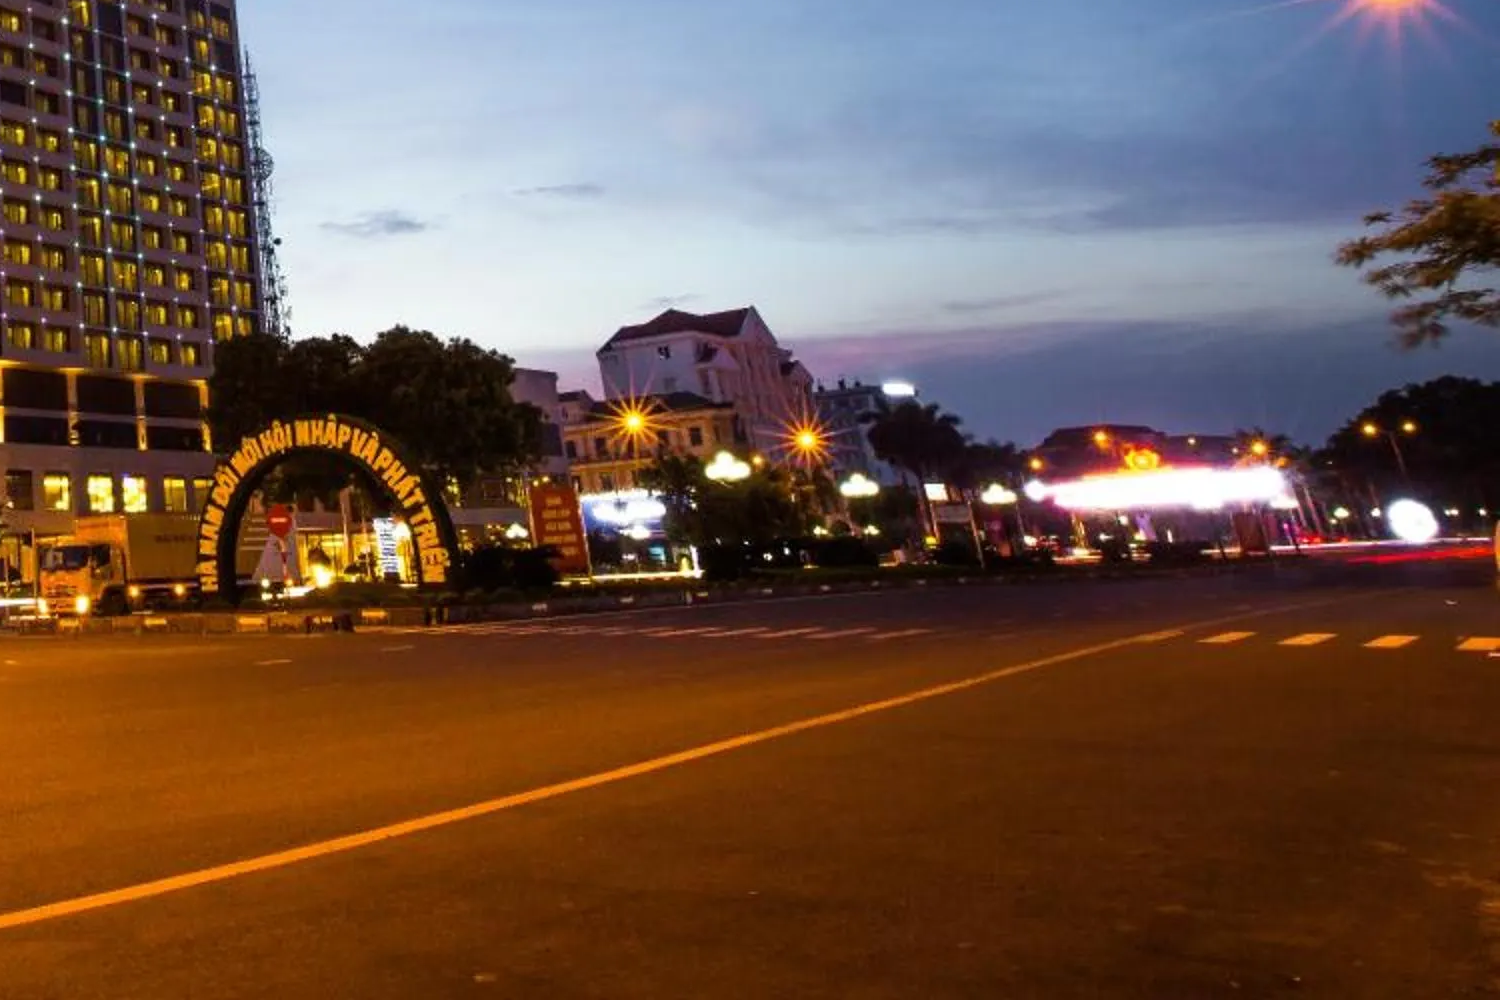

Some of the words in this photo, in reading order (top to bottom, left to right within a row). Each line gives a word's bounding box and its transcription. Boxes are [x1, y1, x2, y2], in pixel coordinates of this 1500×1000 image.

[199, 504, 225, 555] NAM
[258, 419, 293, 457] HỘI
[294, 412, 351, 450] NHẬP
[350, 429, 379, 466] VÀ
[372, 447, 425, 509] PHÁT
